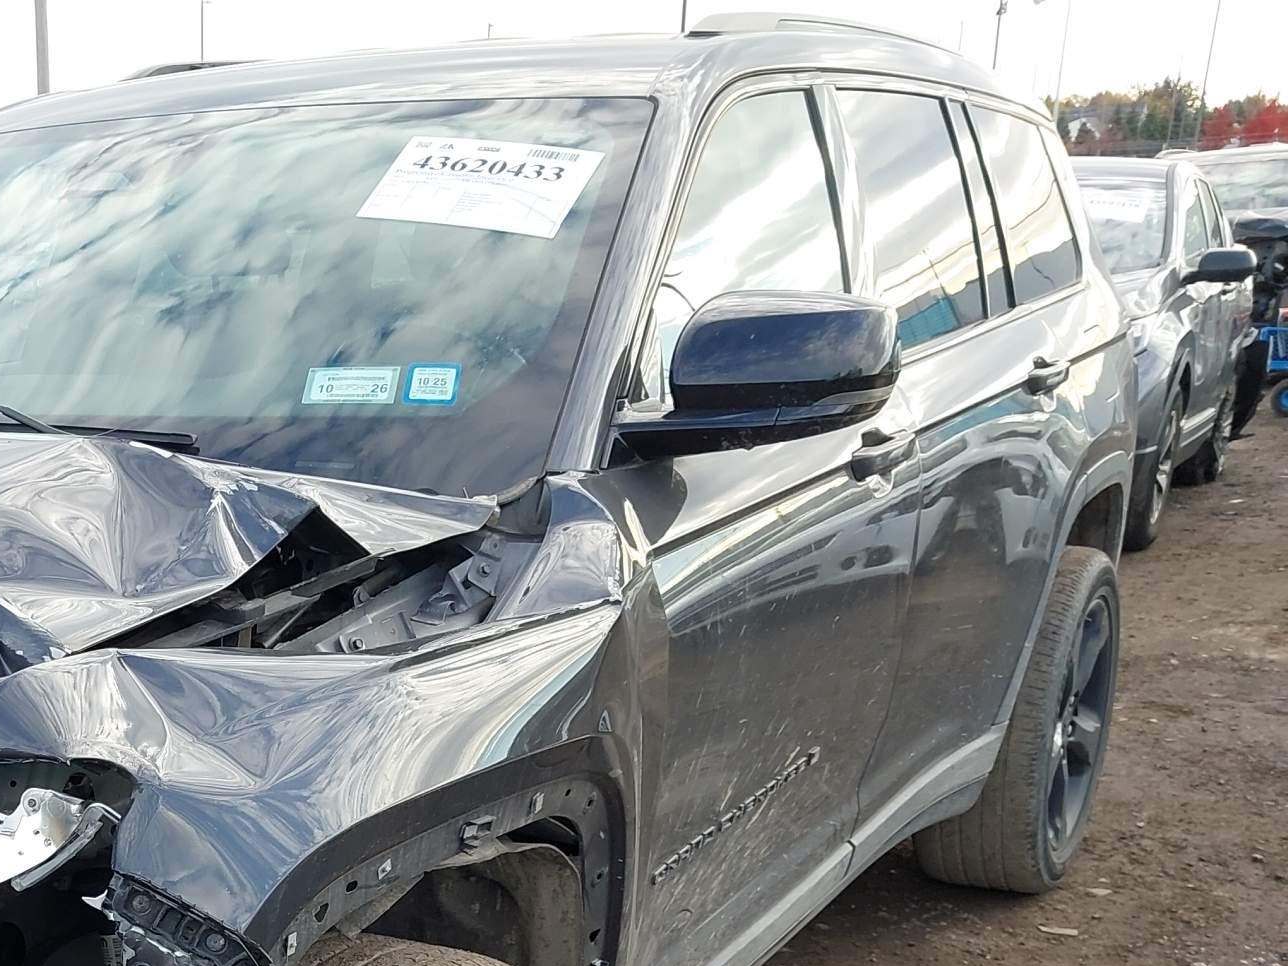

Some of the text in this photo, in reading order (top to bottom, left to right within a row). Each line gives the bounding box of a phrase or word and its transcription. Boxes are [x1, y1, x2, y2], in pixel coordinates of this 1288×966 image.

[412, 155, 566, 182] 43620433
[318, 383, 388, 394] 10 26
